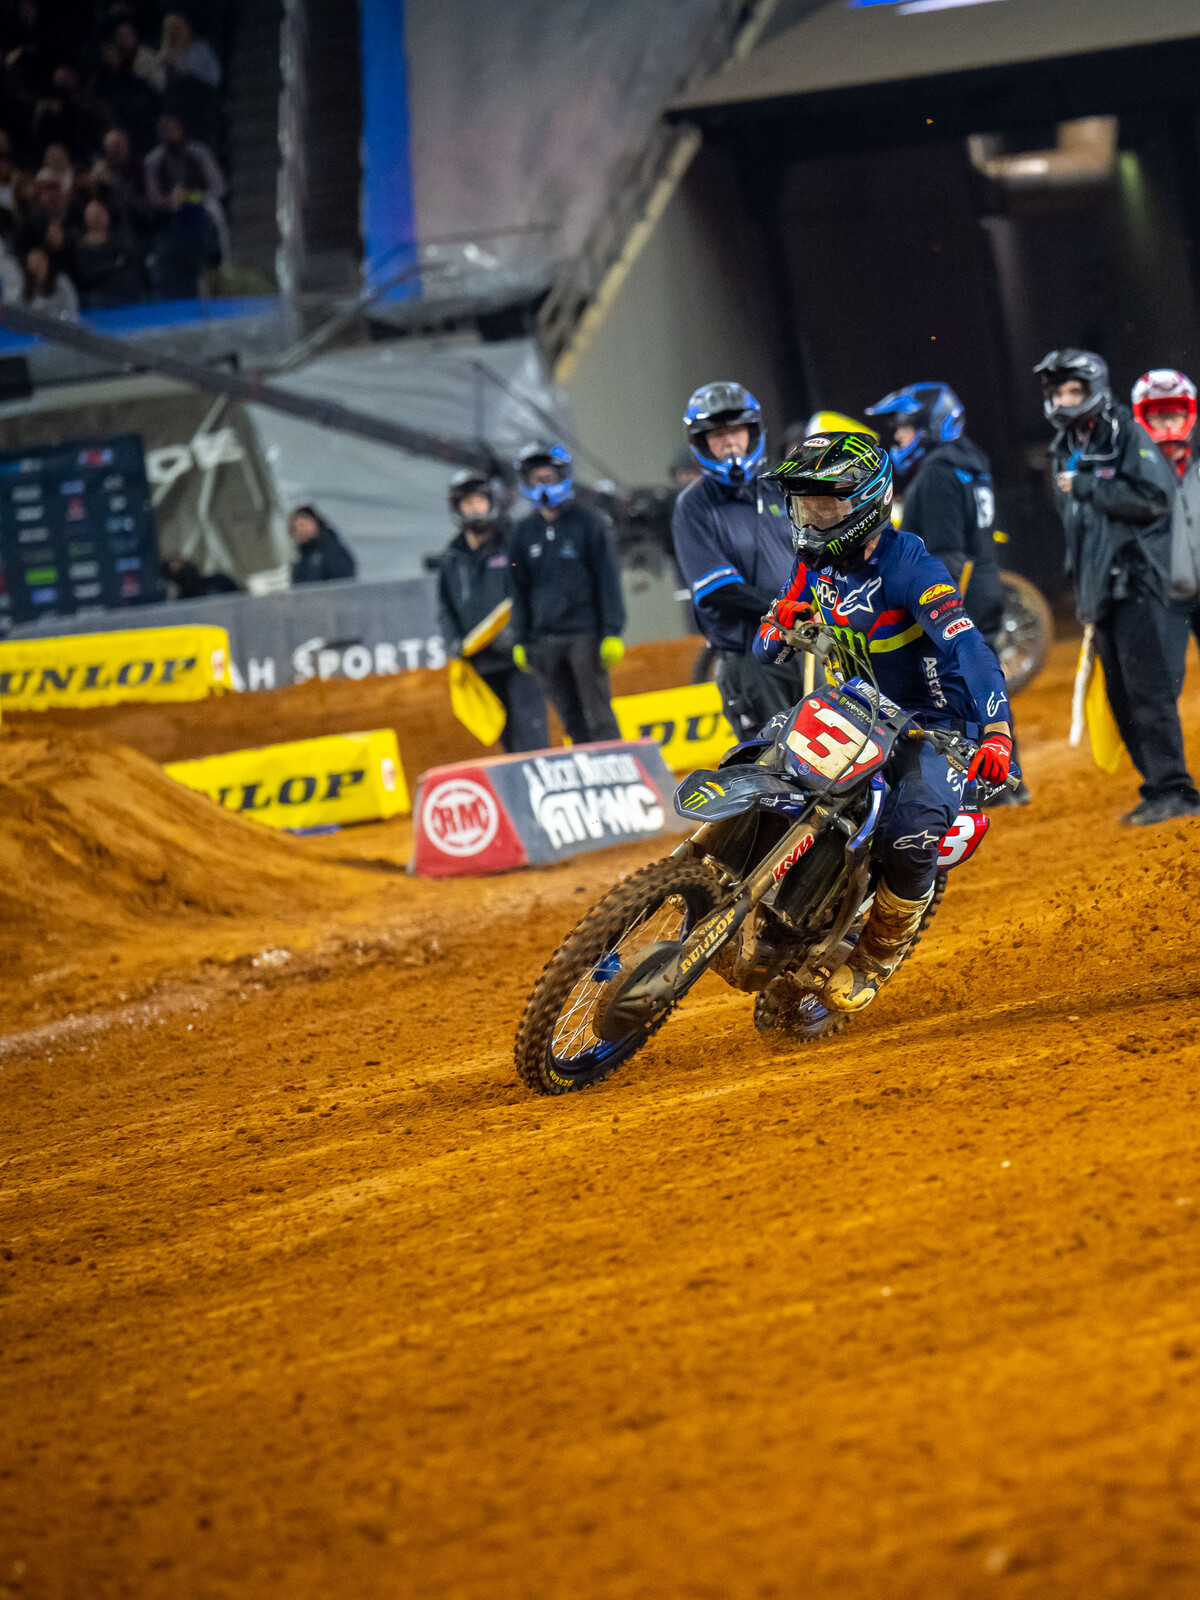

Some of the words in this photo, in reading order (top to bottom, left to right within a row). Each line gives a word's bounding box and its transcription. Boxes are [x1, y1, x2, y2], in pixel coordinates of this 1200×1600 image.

[840, 509, 879, 542] MONSTER
[946, 619, 972, 636] BELL
[292, 635, 447, 685] SPORTS
[922, 656, 948, 709] Astars
[845, 700, 873, 723] MONSTE
[786, 707, 880, 781] 3
[936, 815, 976, 866] 3
[549, 1070, 574, 1087] DUNLOP
